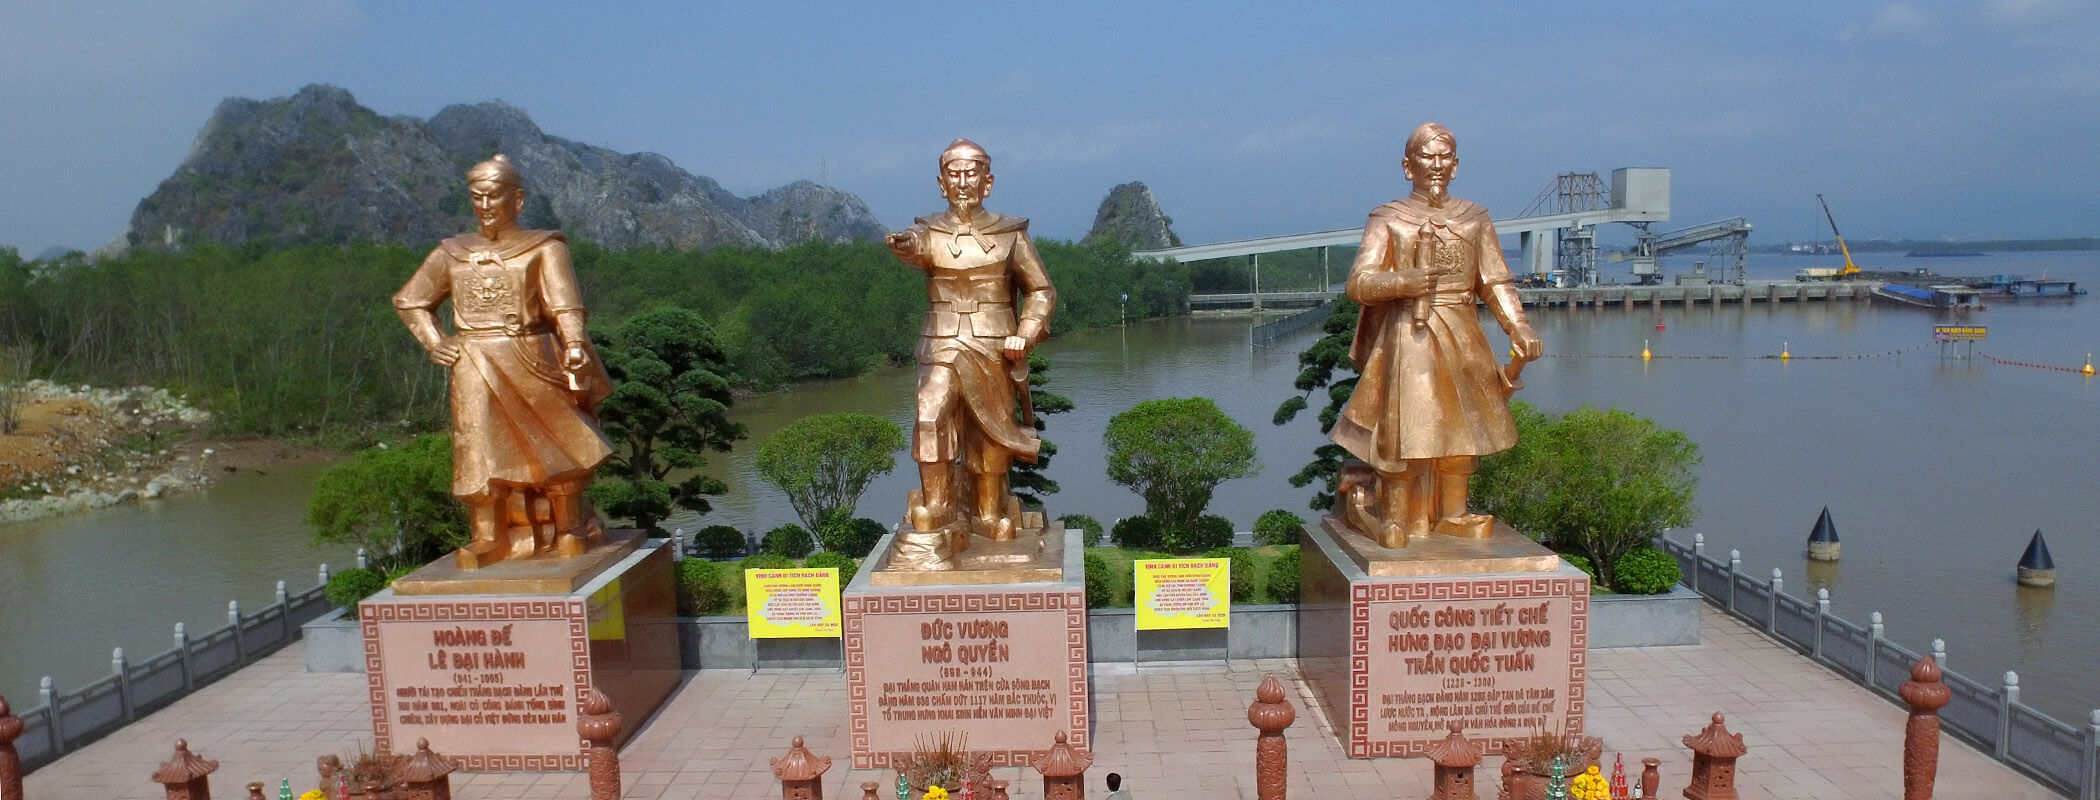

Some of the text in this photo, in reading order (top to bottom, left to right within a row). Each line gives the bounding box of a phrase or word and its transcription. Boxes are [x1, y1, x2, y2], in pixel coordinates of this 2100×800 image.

[1389, 600, 1550, 631] QUỐC CÔNG TIẾT CHẾ
[433, 623, 514, 646] HOÀNG ĐẾ
[921, 618, 1008, 640] ĐỨC VƯƠNG
[1388, 628, 1551, 653] HƯNG ĐẠO ĐẠI VƯƠNG
[428, 648, 525, 671] LÊ ĐẠI HÀNH
[922, 639, 1009, 665] NGÔ QUYỀN
[1405, 649, 1535, 675] TRẦN QUỐC TUẤN
